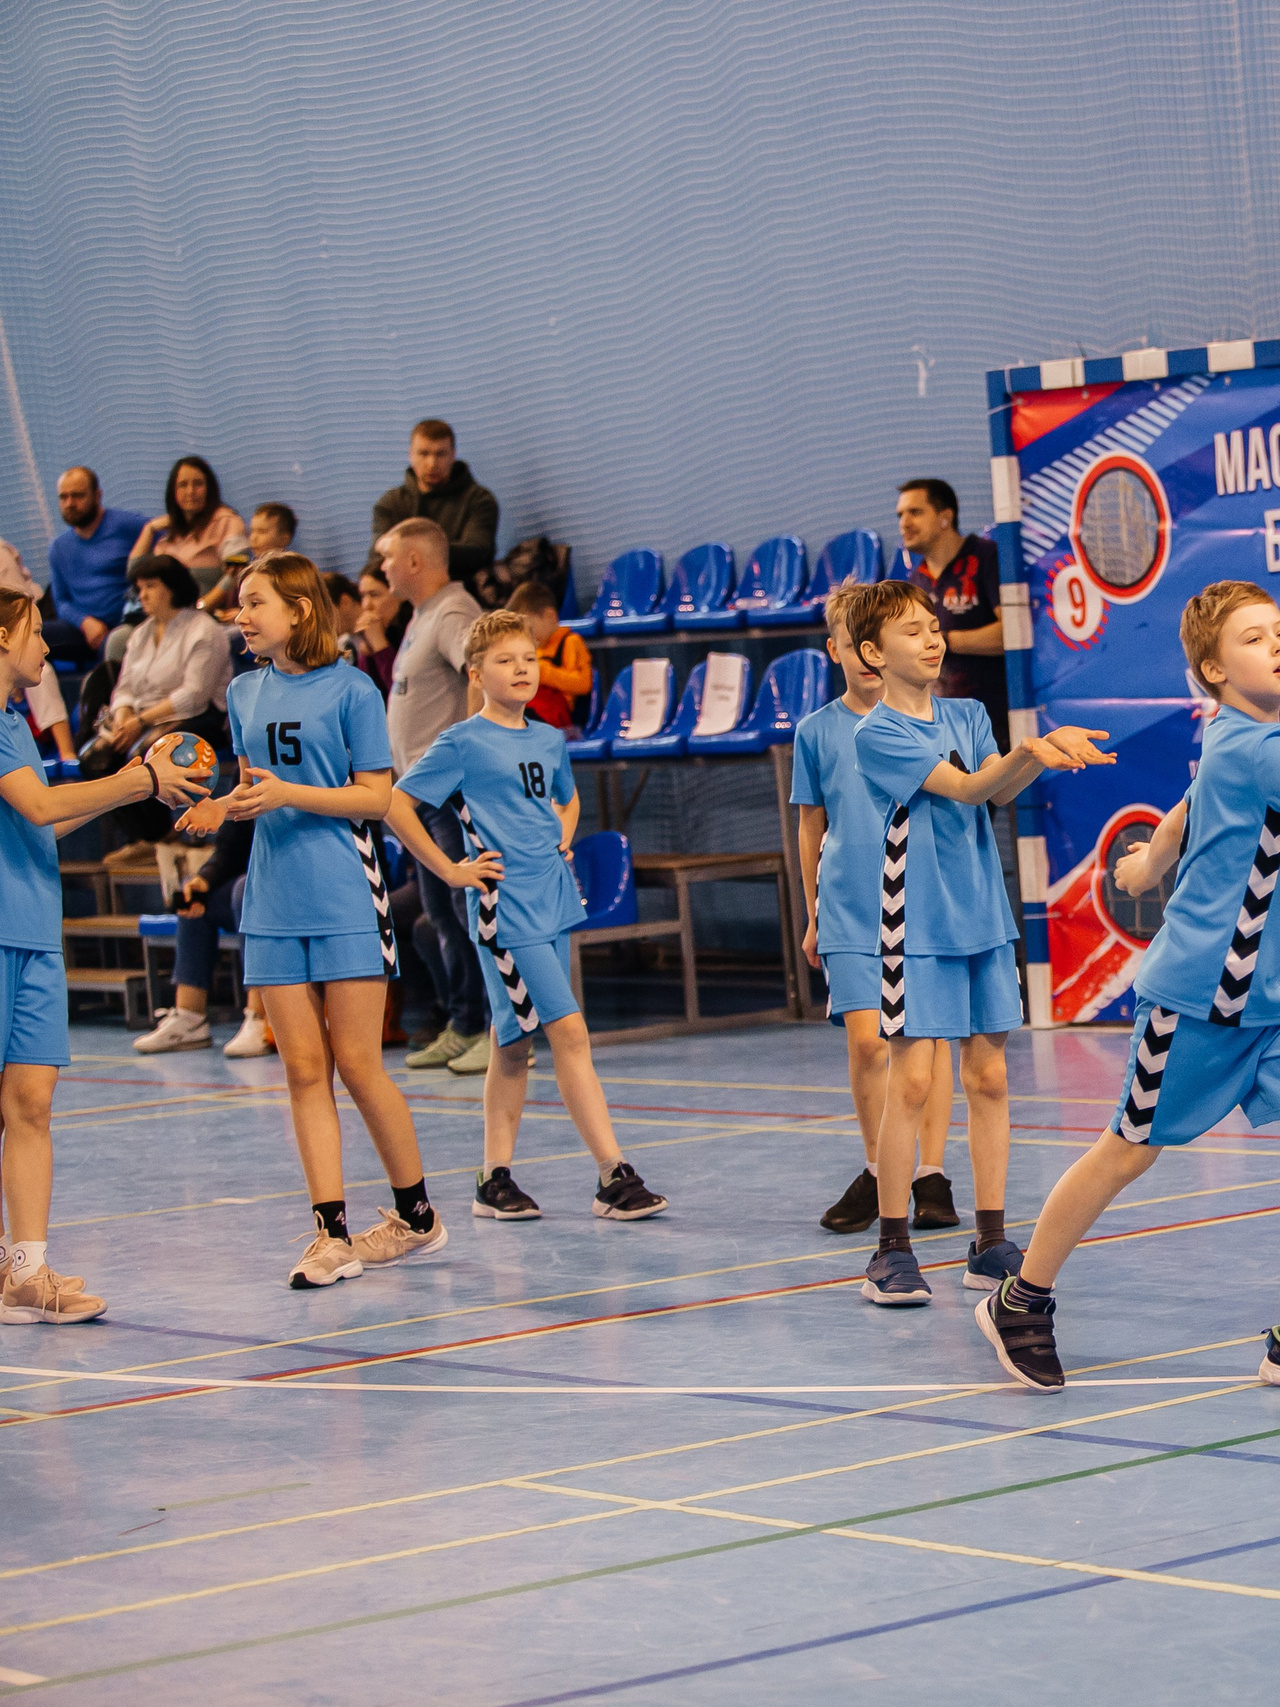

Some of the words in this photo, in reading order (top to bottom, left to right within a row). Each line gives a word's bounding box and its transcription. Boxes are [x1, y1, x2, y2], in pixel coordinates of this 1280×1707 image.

[1067, 577, 1087, 629] 9
[265, 721, 303, 767] 15
[518, 761, 546, 799] 18
